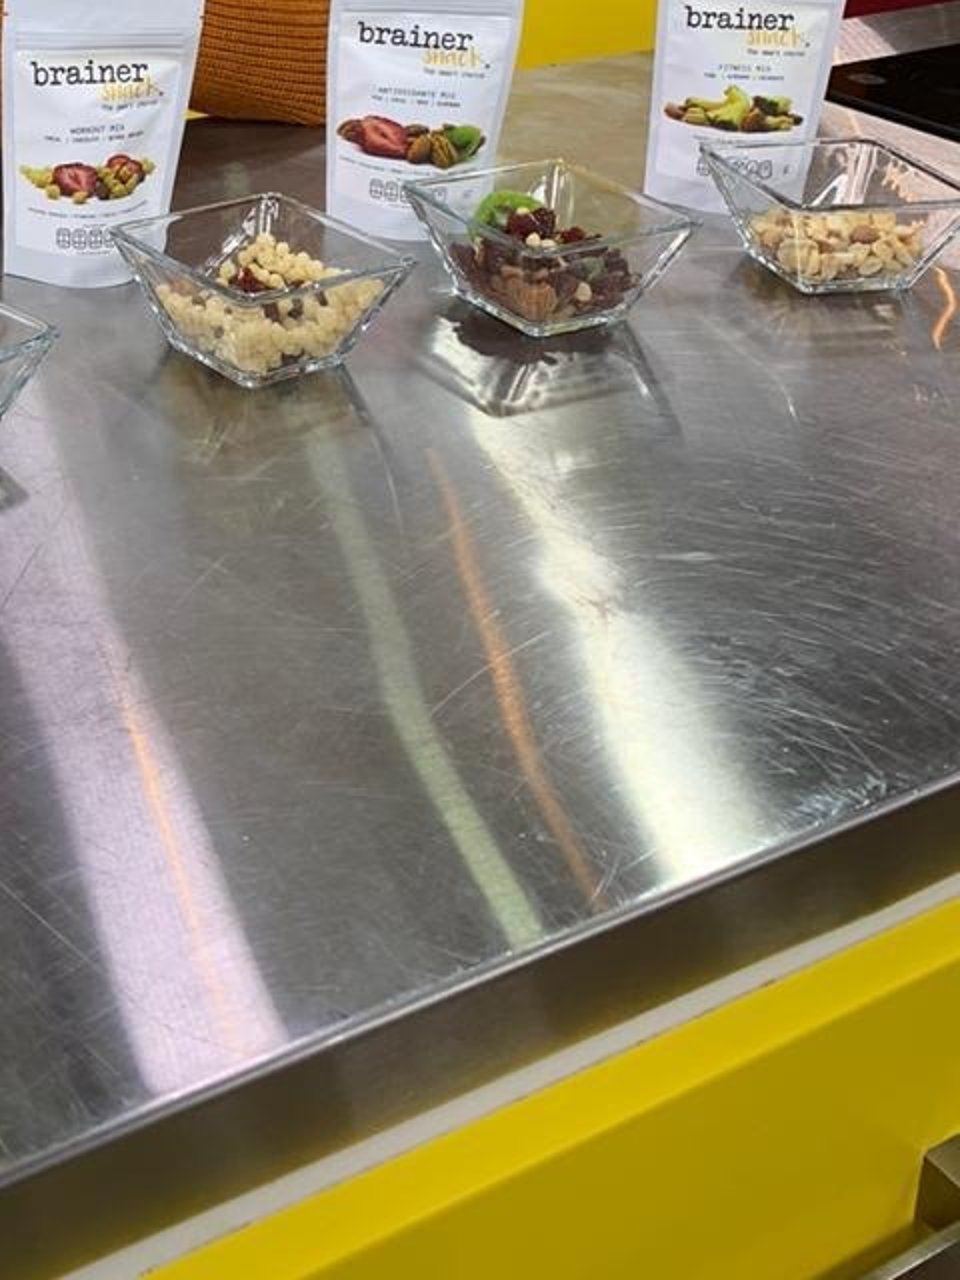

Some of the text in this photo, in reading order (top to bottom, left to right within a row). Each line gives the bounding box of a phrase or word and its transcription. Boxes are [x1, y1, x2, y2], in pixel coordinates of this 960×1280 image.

[685, 5, 795, 31] brainer
[357, 21, 474, 51] brainer
[30, 59, 148, 87] brainer
